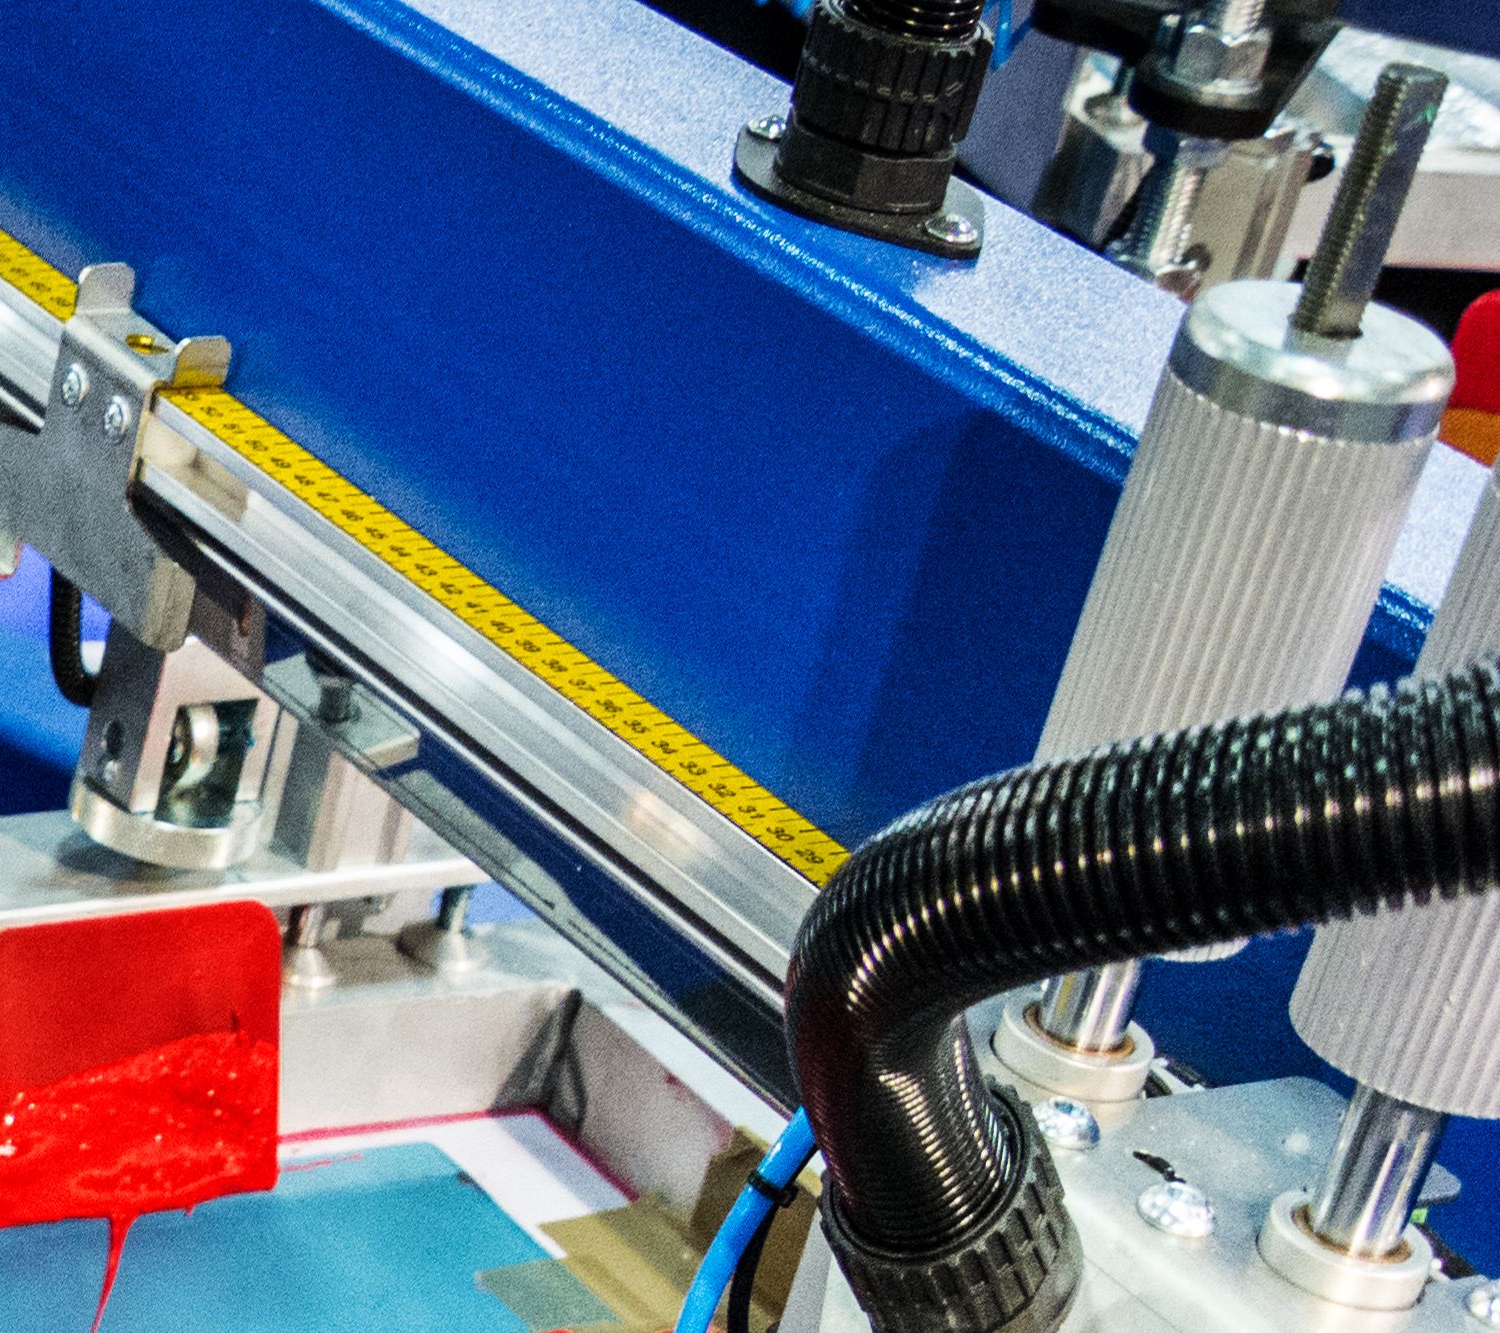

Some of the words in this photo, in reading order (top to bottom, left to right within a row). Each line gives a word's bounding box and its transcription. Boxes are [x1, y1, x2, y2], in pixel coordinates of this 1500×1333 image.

[340, 508, 365, 521] 46
[364, 526, 388, 540] 45
[389, 544, 412, 557] 44
[413, 562, 439, 577] 43
[439, 581, 464, 595] 42
[465, 601, 489, 614] 41
[490, 619, 515, 633] 40
[514, 639, 542, 653] 39
[541, 658, 569, 672] 38
[567, 678, 597, 692] 37
[594, 699, 624, 714] 36
[622, 719, 651, 734] 35
[650, 740, 679, 755] 34
[678, 760, 708, 776] 33
[707, 782, 737, 798] 32
[737, 805, 766, 819] 31
[765, 826, 796, 842] 30
[794, 848, 825, 864] 29
